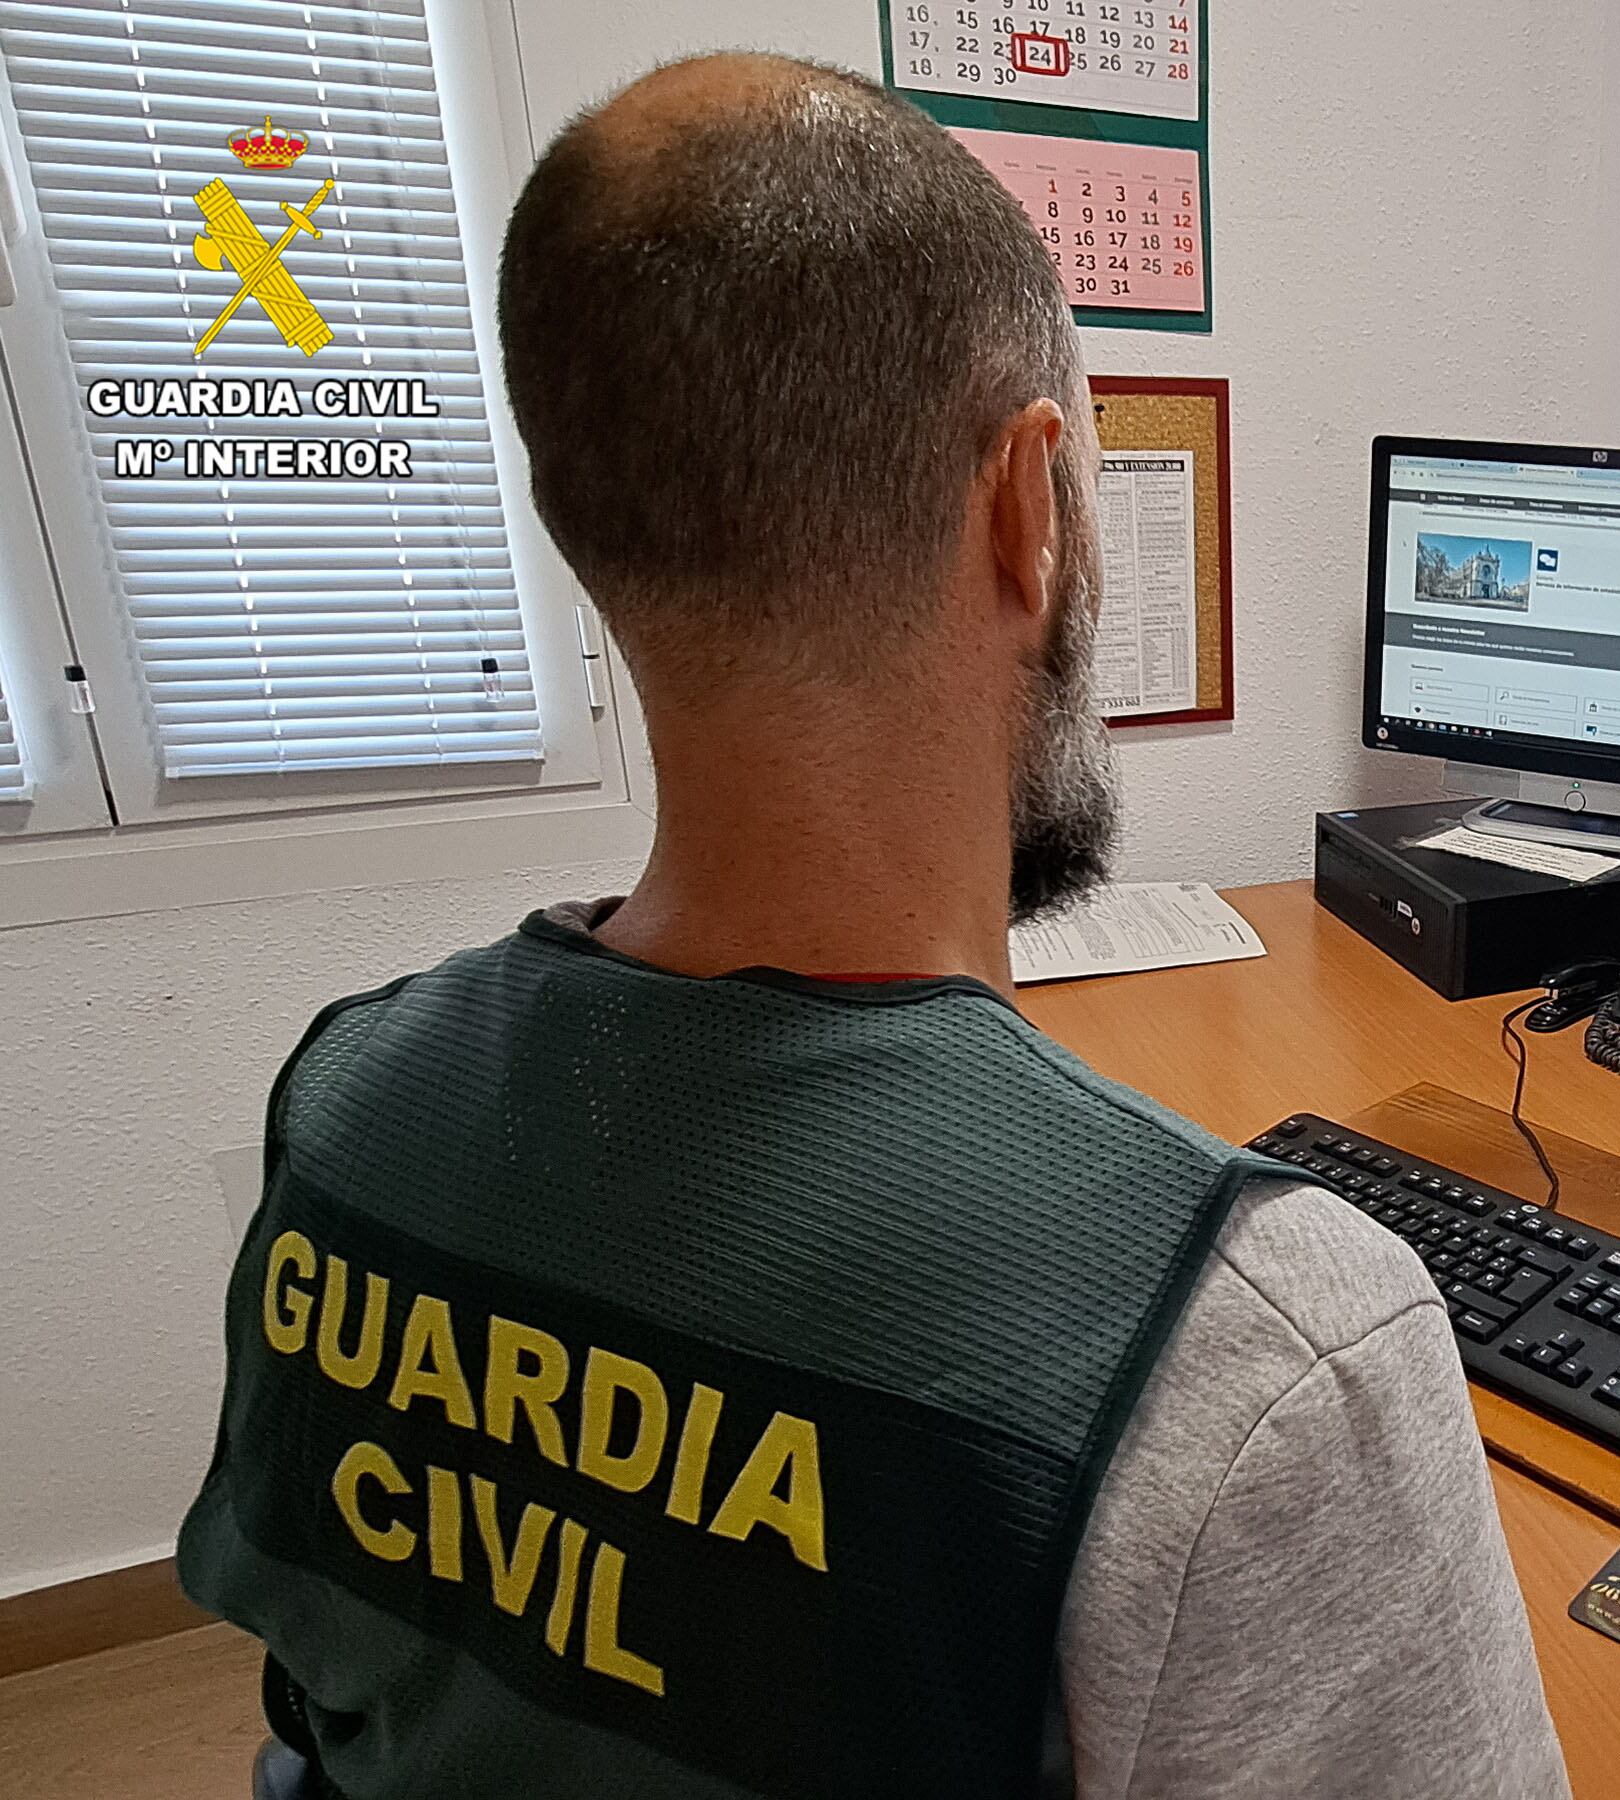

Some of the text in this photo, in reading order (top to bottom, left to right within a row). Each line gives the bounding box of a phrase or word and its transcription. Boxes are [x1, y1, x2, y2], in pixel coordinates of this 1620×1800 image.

[956, 9, 978, 29] 15
[992, 17, 1015, 34] 16
[1029, 21, 1050, 36] 17
[1065, 27, 1086, 44] 18
[1100, 30, 1121, 48] 19
[1133, 35, 1155, 51] 20
[1169, 39, 1189, 55] 21
[1065, 1, 1086, 17] 11
[1099, 6, 1120, 22] 12
[1134, 11, 1155, 29] 13
[1168, 15, 1189, 34] 14
[956, 37, 980, 53] 22
[1029, 46, 1051, 66] 24
[1099, 54, 1122, 72] 26
[1134, 60, 1156, 78] 27
[1167, 63, 1189, 80] 28
[956, 62, 981, 83] 29
[993, 67, 1017, 85] 30
[1048, 178, 1192, 207] 1 2 3 4 5
[1048, 201, 1192, 228] 8 9 10 11 12
[1040, 227, 1193, 253] 15 16 17 18 19
[1075, 254, 1096, 270] 23
[1108, 255, 1129, 272] 24
[1141, 258, 1162, 274] 25
[1173, 261, 1194, 277] 26
[1075, 278, 1131, 295] 30 31
[264, 1230, 829, 1573] GUARDIA
[331, 1440, 666, 1698] CIVIL
